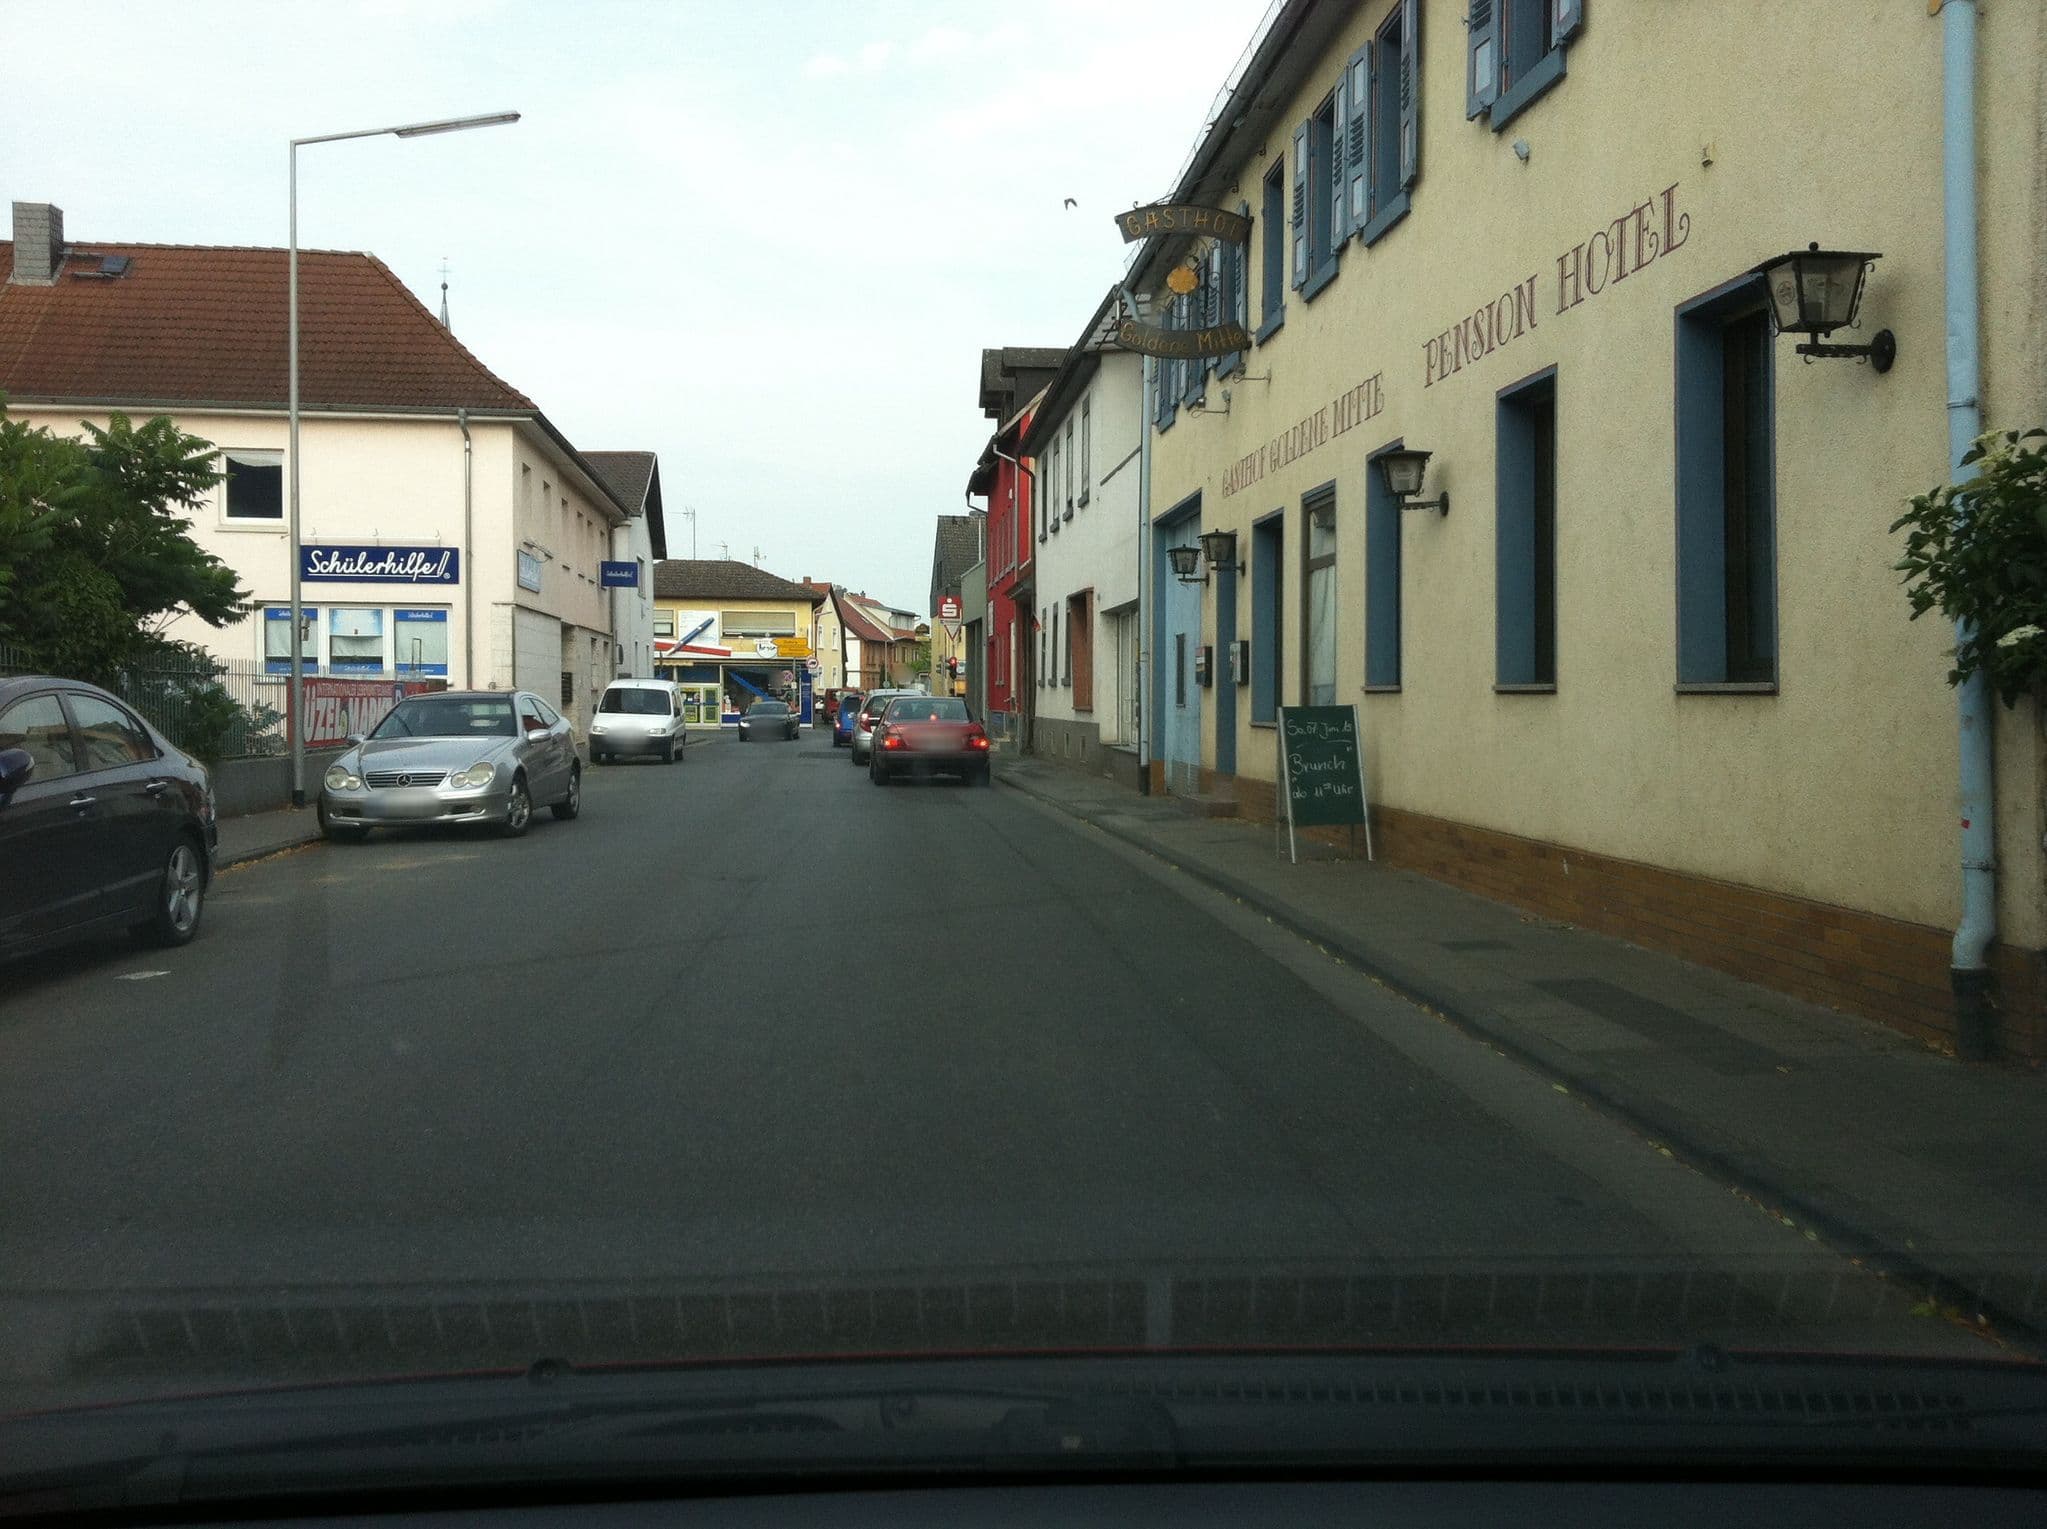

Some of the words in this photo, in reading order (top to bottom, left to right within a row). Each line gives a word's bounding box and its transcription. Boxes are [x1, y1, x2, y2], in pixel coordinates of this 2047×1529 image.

[1222, 445, 1266, 497] GASTHOF
[1270, 406, 1329, 473] GOLDENE
[1332, 369, 1385, 438] MITTE
[1422, 274, 1538, 388] PENSION
[1556, 182, 1690, 315] HOTEL
[303, 684, 343, 742] ÜZEL
